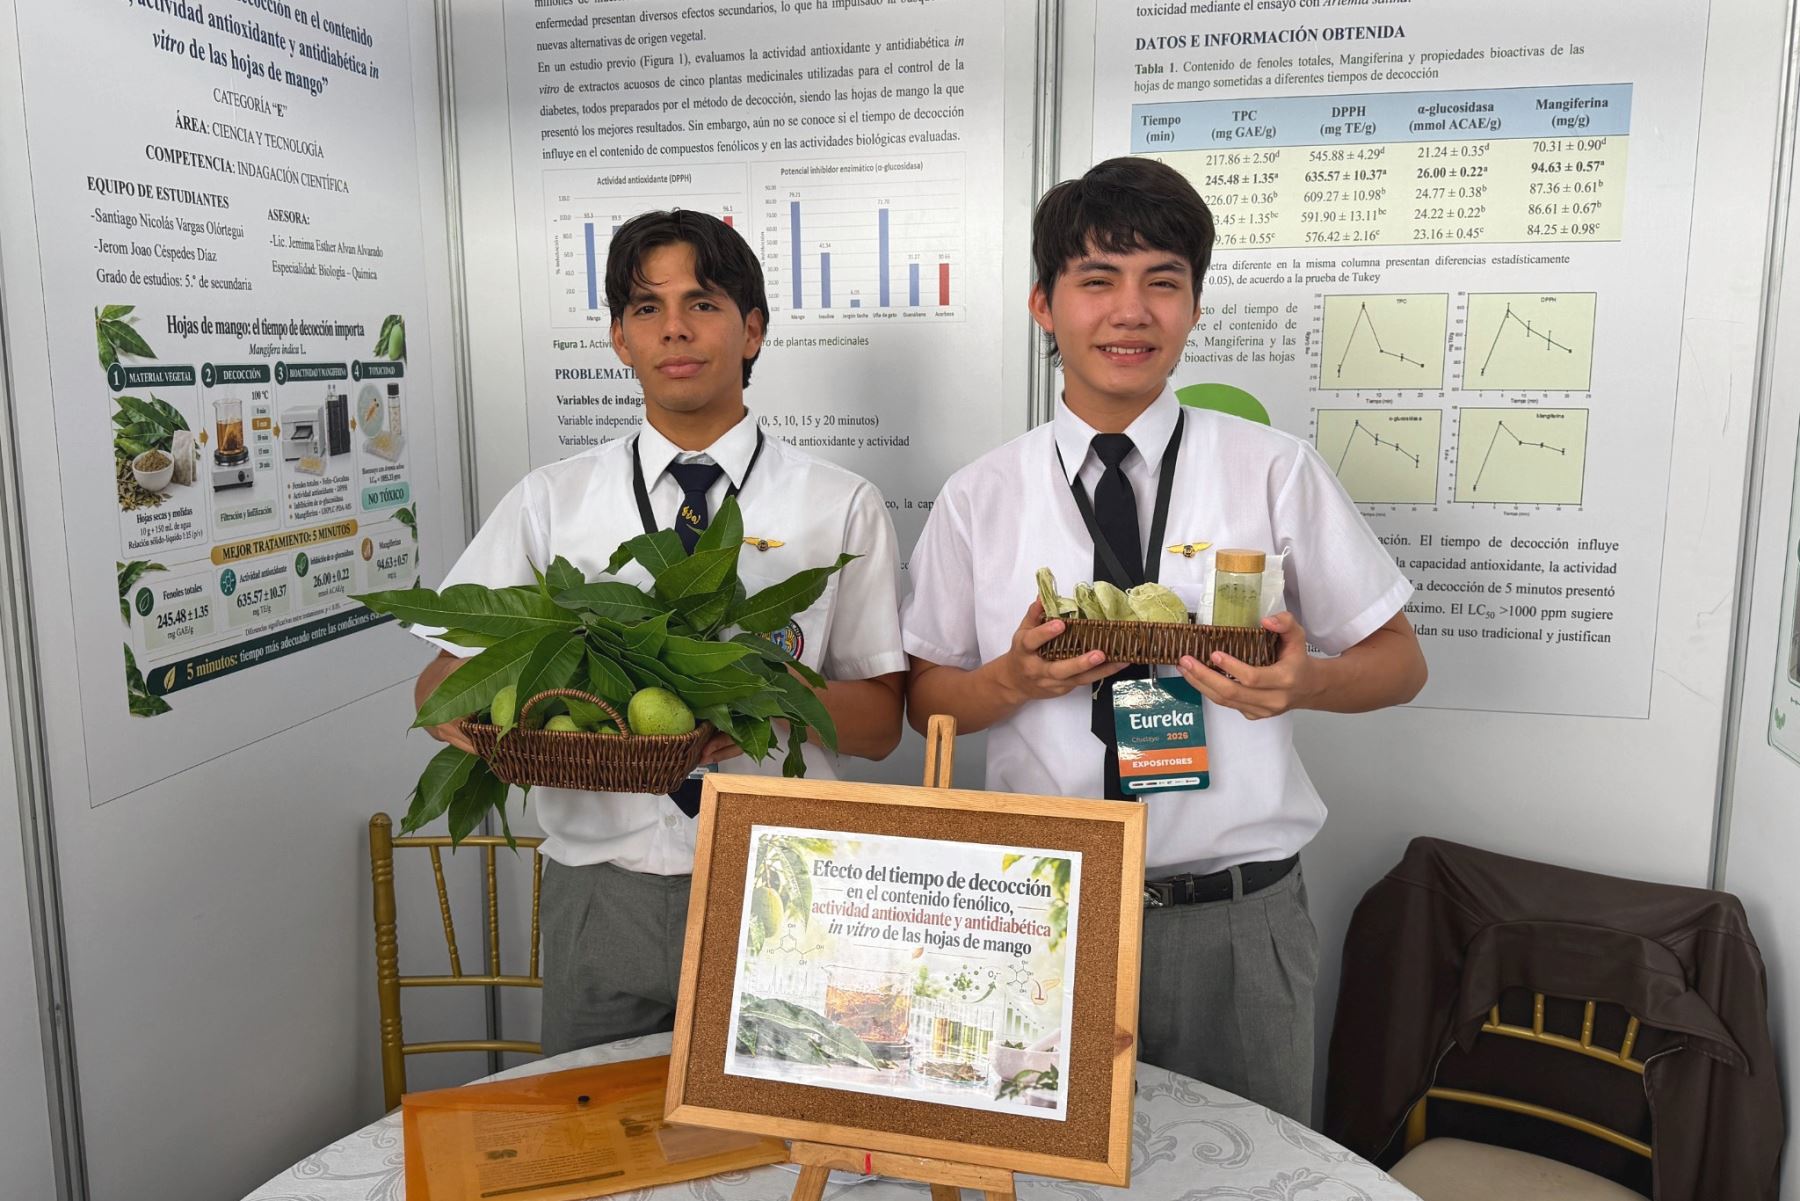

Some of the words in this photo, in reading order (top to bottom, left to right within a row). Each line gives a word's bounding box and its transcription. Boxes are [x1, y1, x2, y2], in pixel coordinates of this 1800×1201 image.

[294, 8, 308, 25] en
[310, 11, 321, 29] el
[322, 19, 373, 47] contenido
[536, 41, 568, 51] nuevas
[569, 35, 623, 49] alternativas
[624, 33, 636, 45] de
[637, 32, 668, 47] origen
[669, 29, 706, 44] vegetal.
[1135, 35, 1187, 50] DATOS
[1190, 34, 1200, 47] E
[1204, 28, 1318, 46] INFORMACIÓN
[1322, 25, 1405, 40] OBTENIDA
[152, 31, 185, 55] vitro
[188, 38, 206, 61] de
[207, 42, 228, 67] las
[230, 49, 265, 79] hojas
[267, 61, 282, 82] de
[207, 13, 286, 49] antioxidante
[288, 38, 296, 58] y
[298, 42, 367, 75] antidiabética
[369, 60, 379, 79] in
[1133, 63, 1164, 75] Tabla
[1170, 62, 1178, 73] 1.
[1182, 59, 1235, 72] Contenido
[1238, 57, 1252, 70] de
[1256, 56, 1293, 69] fenoles
[1298, 54, 1334, 67] totales,
[1339, 51, 1403, 67] Mangiferina
[1407, 53, 1416, 65] y
[1420, 48, 1485, 64] propiedades
[1489, 45, 1545, 58] bioactivas
[1550, 43, 1564, 56] de
[1569, 43, 1584, 55] las
[212, 87, 272, 114] CATEGORÍA
[1331, 105, 1366, 117] DPPH
[1535, 97, 1608, 112] Mangiferina
[1140, 115, 1181, 128] Tiempo
[1231, 109, 1257, 121] TPC
[174, 109, 210, 134] ÁREA:
[211, 122, 255, 143] CIENCIA
[255, 130, 262, 145] Y
[263, 133, 324, 158] TECNOLOGÍA
[542, 147, 574, 161] influye
[575, 149, 587, 158] en
[588, 145, 598, 157] el
[599, 144, 645, 157] contenido
[646, 143, 658, 155] de
[659, 143, 714, 156] compuestos
[716, 139, 759, 152] fenólicos
[760, 141, 768, 153] y
[769, 141, 782, 150] en
[784, 137, 798, 149] las
[799, 134, 854, 148] actividades
[855, 132, 906, 147] biológicas
[908, 130, 960, 143] evaluadas.
[145, 144, 235, 173] COMPETENCIA:
[236, 161, 299, 184] INDAGACIÓN
[300, 172, 349, 193] CIENTÍFICA
[596, 176, 627, 186] Actividad
[628, 174, 668, 185] antioxidante
[669, 173, 692, 184] (DPPH)
[780, 166, 809, 176] Potencial
[810, 164, 838, 174] inhibidor
[839, 163, 874, 173] enzimático
[86, 176, 135, 196] EQUIPO
[136, 183, 154, 199] DE
[155, 186, 229, 208] ESTUDIANTES
[90, 207, 138, 229] -Santiago
[138, 212, 174, 230] Nicolás
[174, 217, 205, 237] Vargas
[205, 220, 244, 240] Olórtegui
[93, 238, 129, 254] -Jerom
[130, 241, 152, 256] Joao
[153, 243, 196, 262] Céspedes
[95, 268, 127, 284] Grado
[129, 270, 141, 285] de
[142, 272, 182, 287] estudios:
[198, 274, 209, 288] de
[210, 277, 252, 290] secundaria
[166, 314, 199, 339] Hojas
[200, 315, 213, 334] de
[214, 321, 251, 339] mango:
[251, 317, 260, 335] el
[260, 317, 288, 340] tiempo
[288, 318, 298, 336] de
[298, 319, 334, 336] decocción
[334, 320, 365, 340] importa
[773, 338, 784, 347] de
[786, 337, 817, 348] plantas
[819, 336, 869, 346] medicinales
[113, 371, 120, 385] 1
[129, 373, 164, 383] MATERIAL
[166, 372, 192, 382] VEGETAL
[205, 369, 212, 382] 2
[223, 369, 261, 380] DECOCCIÓN
[758, 416, 769, 427] (0,
[772, 415, 782, 427] 5,
[784, 415, 798, 427] 10,
[801, 415, 812, 426] 15
[814, 417, 821, 428] y
[823, 414, 835, 425] 20
[837, 414, 879, 427] minutos)
[368, 491, 378, 505] NO
[379, 487, 405, 502] TÓXICO
[222, 544, 251, 560] MEJOR
[252, 533, 311, 554] TRATAMIENTO:
[312, 529, 317, 541] 5
[318, 524, 351, 539] MINUTOS
[1419, 534, 1432, 546] El
[1440, 535, 1480, 550] tiempo
[1487, 535, 1502, 548] de
[1509, 536, 1568, 549] decocción
[1577, 538, 1619, 553] influye
[186, 662, 194, 680] 5
[195, 654, 240, 676] minutos:
[238, 647, 264, 663] tiempo
[264, 639, 280, 654] más
[279, 630, 310, 649] adecuado
[310, 627, 327, 639] entre
[327, 622, 337, 634] las
[336, 612, 372, 631] condiciones
[1129, 710, 1193, 729] Eureka
[1132, 757, 1193, 768] EXPOSITORES
[813, 859, 862, 879] Efecto
[866, 864, 886, 882] del
[889, 866, 944, 890] tiempo
[946, 870, 966, 889] de
[968, 873, 1051, 897] decocción
[847, 886, 862, 899] en
[867, 885, 878, 900] el
[881, 890, 950, 907] contenido
[952, 893, 1014, 916] fenólico,
[812, 900, 869, 918] actividad
[871, 907, 951, 926] antioxidante
[954, 918, 963, 931] y
[965, 916, 1051, 937] antidiabética
[828, 919, 843, 934] in
[846, 922, 880, 938] vitro
[882, 924, 899, 940] de
[902, 926, 920, 942] las
[924, 928, 960, 949] hojas
[963, 932, 980, 949] de
[983, 939, 1031, 957] mango
